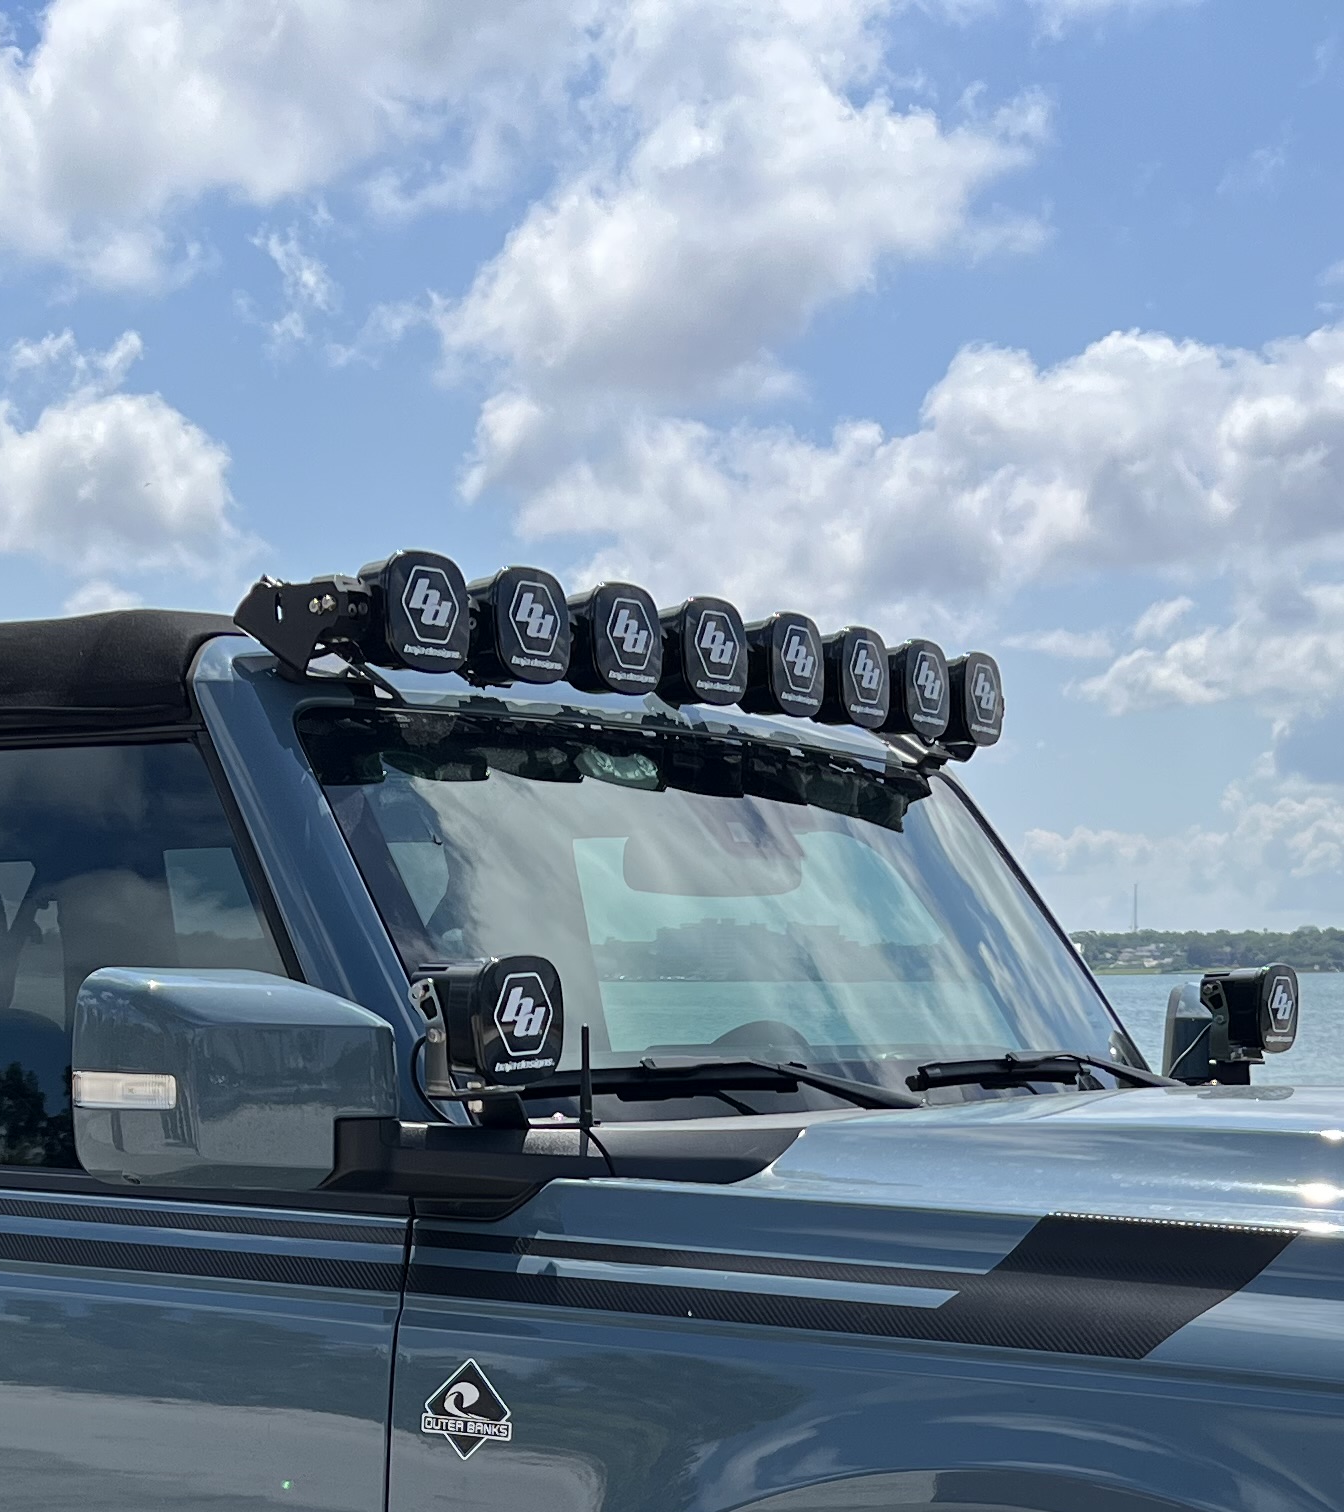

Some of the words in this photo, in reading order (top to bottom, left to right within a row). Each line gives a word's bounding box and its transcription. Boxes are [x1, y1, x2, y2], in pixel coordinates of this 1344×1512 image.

[403, 643, 425, 656] baja
[494, 1060, 519, 1073] baja
[424, 1417, 464, 1432] OUTER
[466, 1421, 508, 1437] BANKS
